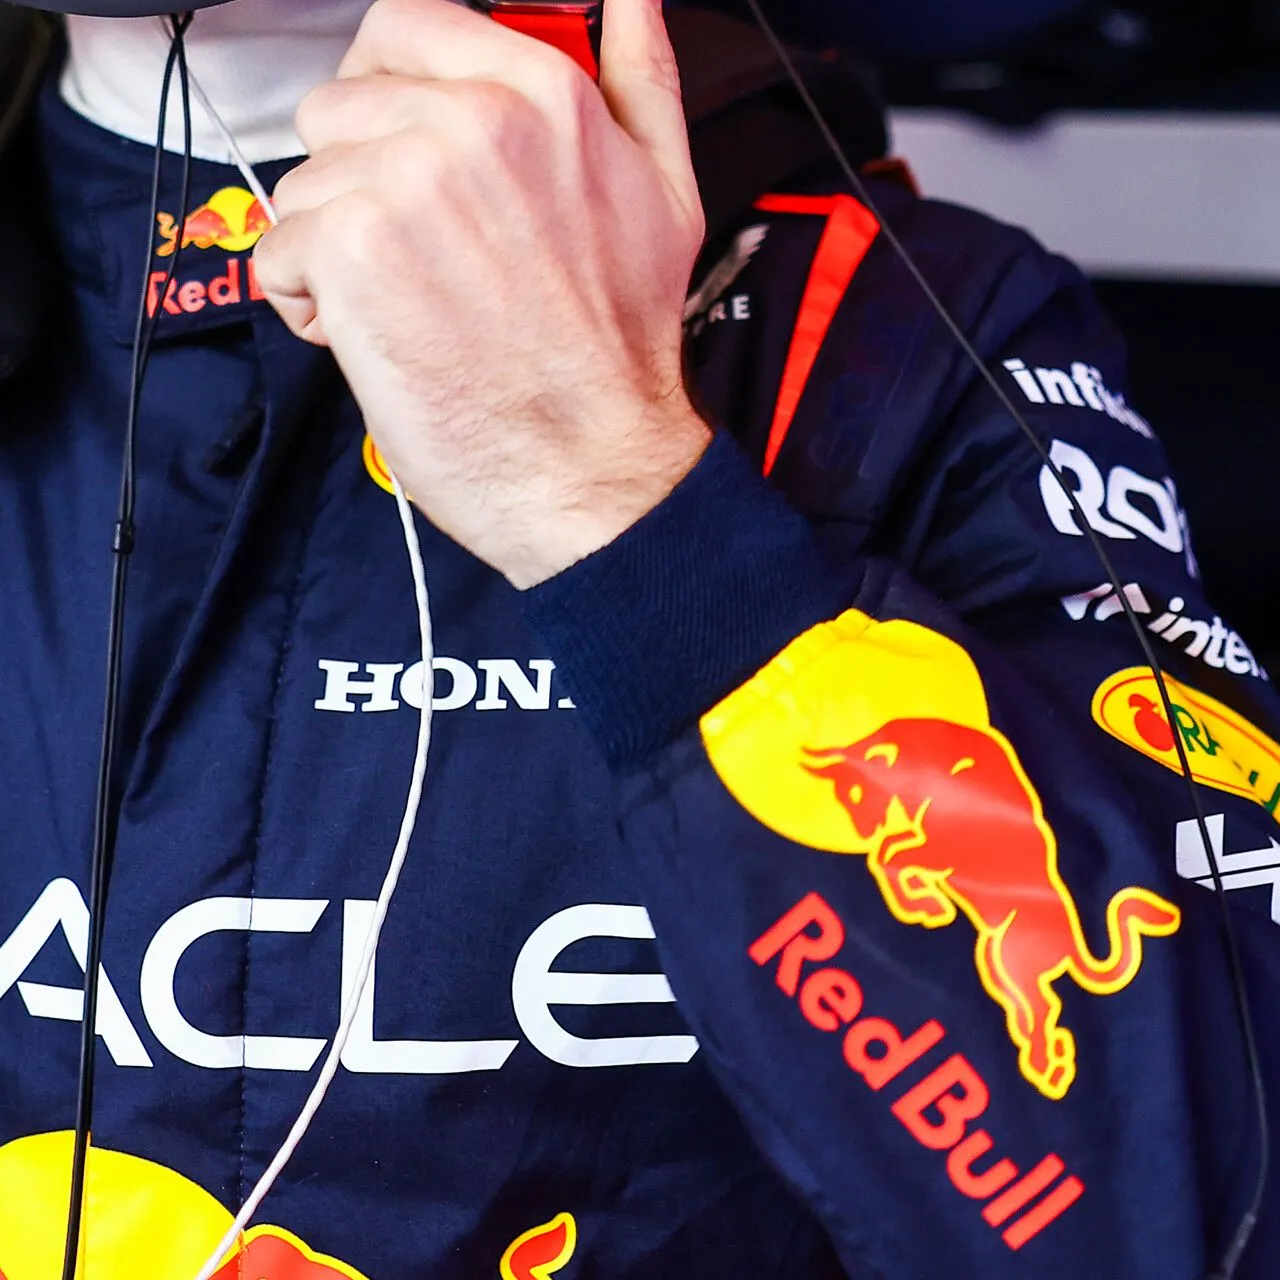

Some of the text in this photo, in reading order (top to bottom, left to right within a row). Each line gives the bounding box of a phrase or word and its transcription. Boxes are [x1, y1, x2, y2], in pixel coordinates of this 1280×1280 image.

[146, 257, 242, 320] Red
[314, 656, 577, 713] HON
[747, 892, 1086, 1252] Red Bull
